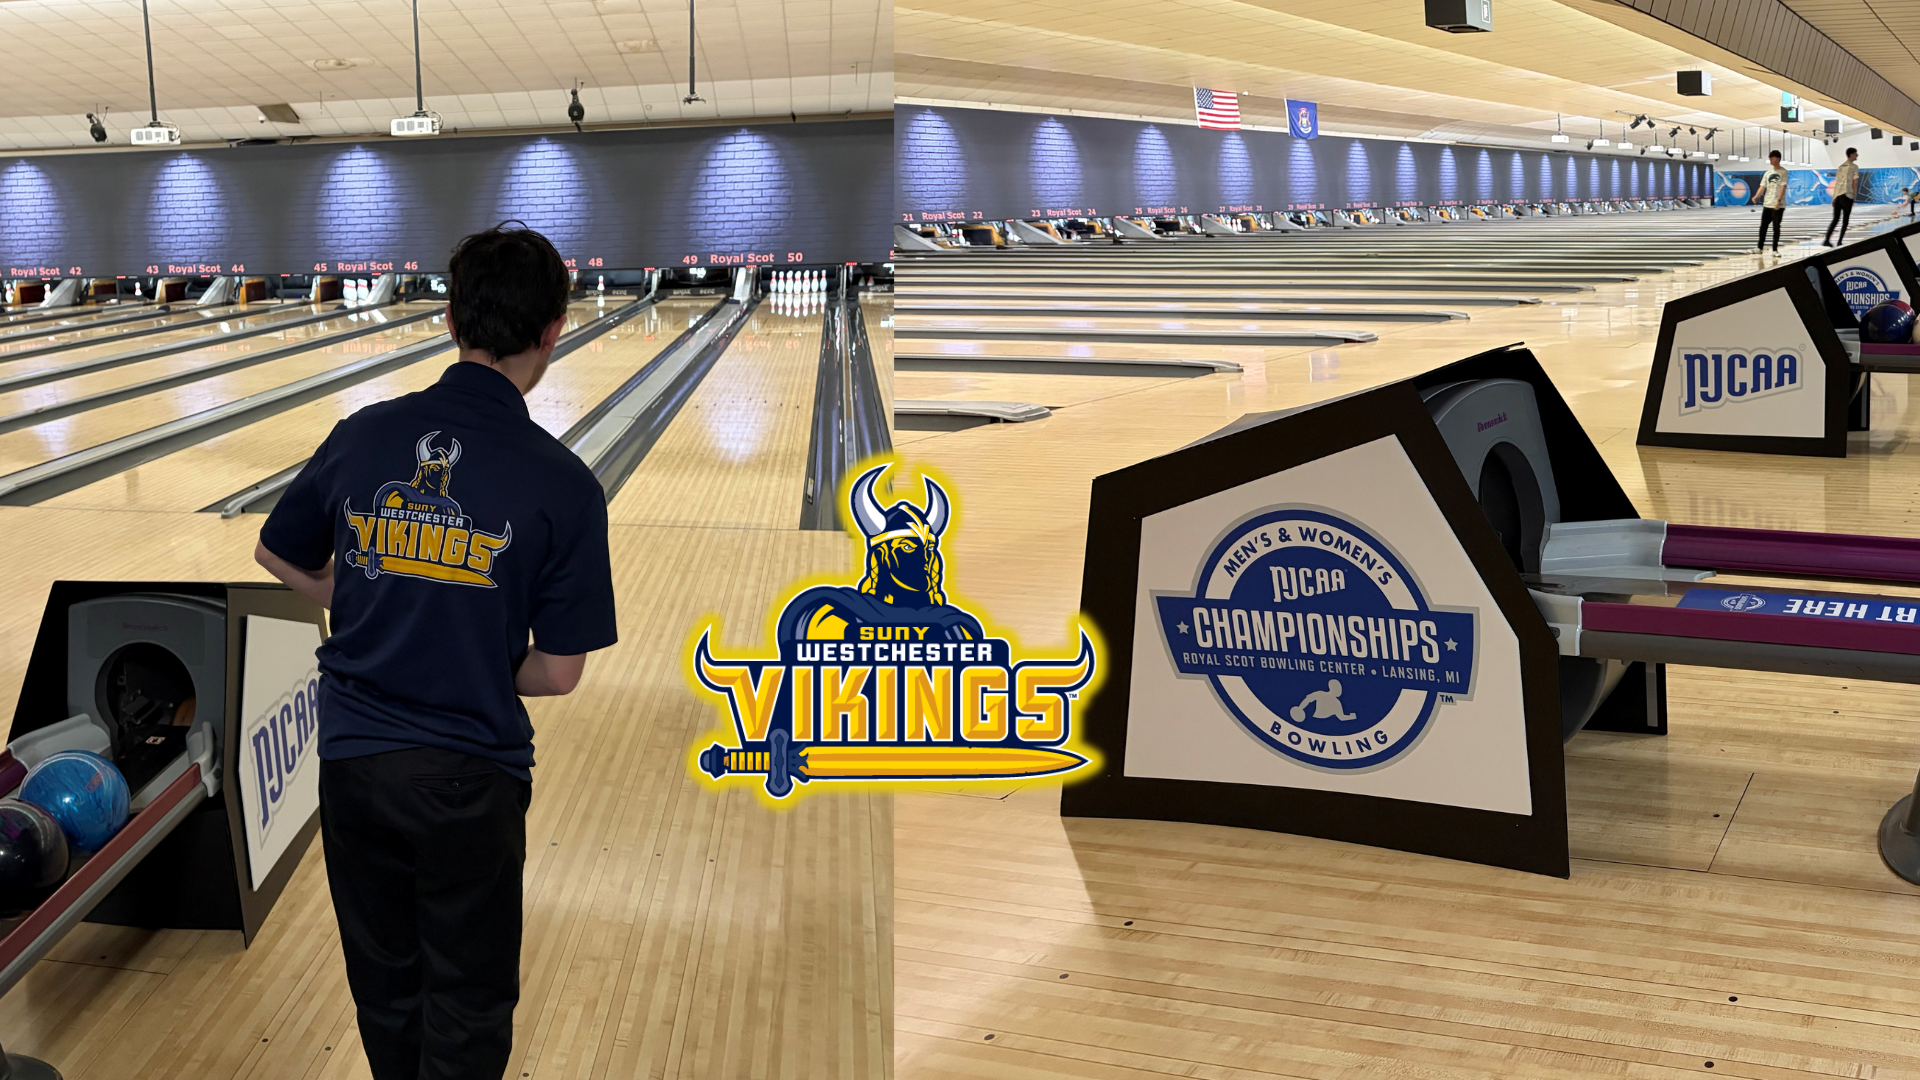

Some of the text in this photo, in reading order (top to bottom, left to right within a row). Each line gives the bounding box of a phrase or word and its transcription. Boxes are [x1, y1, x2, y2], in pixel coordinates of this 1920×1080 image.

[1031, 208, 1097, 218] 23 Royal Scot 24
[1134, 207, 1143, 215] 25
[1147, 207, 1161, 216] Royal
[1163, 206, 1176, 214] Scot
[1228, 205, 1243, 213] Royal
[1243, 204, 1253, 212] Scot
[902, 211, 983, 222] 21 Royal Scot 22
[563, 256, 604, 268] ot 48
[682, 251, 803, 265] 49 Royal Scot 50
[10, 266, 82, 277] Royal Scot 42
[146, 263, 245, 275] 43 Royal Scot 44
[313, 260, 418, 273] 45 Royal Scot 46
[1856, 271, 1880, 286] WOMEN'S
[1845, 281, 1868, 292] NJCAA
[1844, 293, 1890, 304] PIONSHIPS
[1683, 353, 1798, 409] NJCAA
[407, 502, 437, 513] SUNY
[380, 507, 464, 528] WESTCHESTER
[348, 514, 509, 573] VIKINGS
[1222, 525, 1394, 586] MEN'S & WOMEN'S
[1268, 565, 1346, 603] NJCAA
[1782, 598, 1869, 619] HERE
[1192, 606, 1441, 665] CHAMPIONSHIPS
[1183, 651, 1461, 684] ROYAL SCOT BOWLING CENTER LANSING, MI
[1269, 720, 1389, 756] BOWLING
[252, 678, 318, 831] NJCAA
